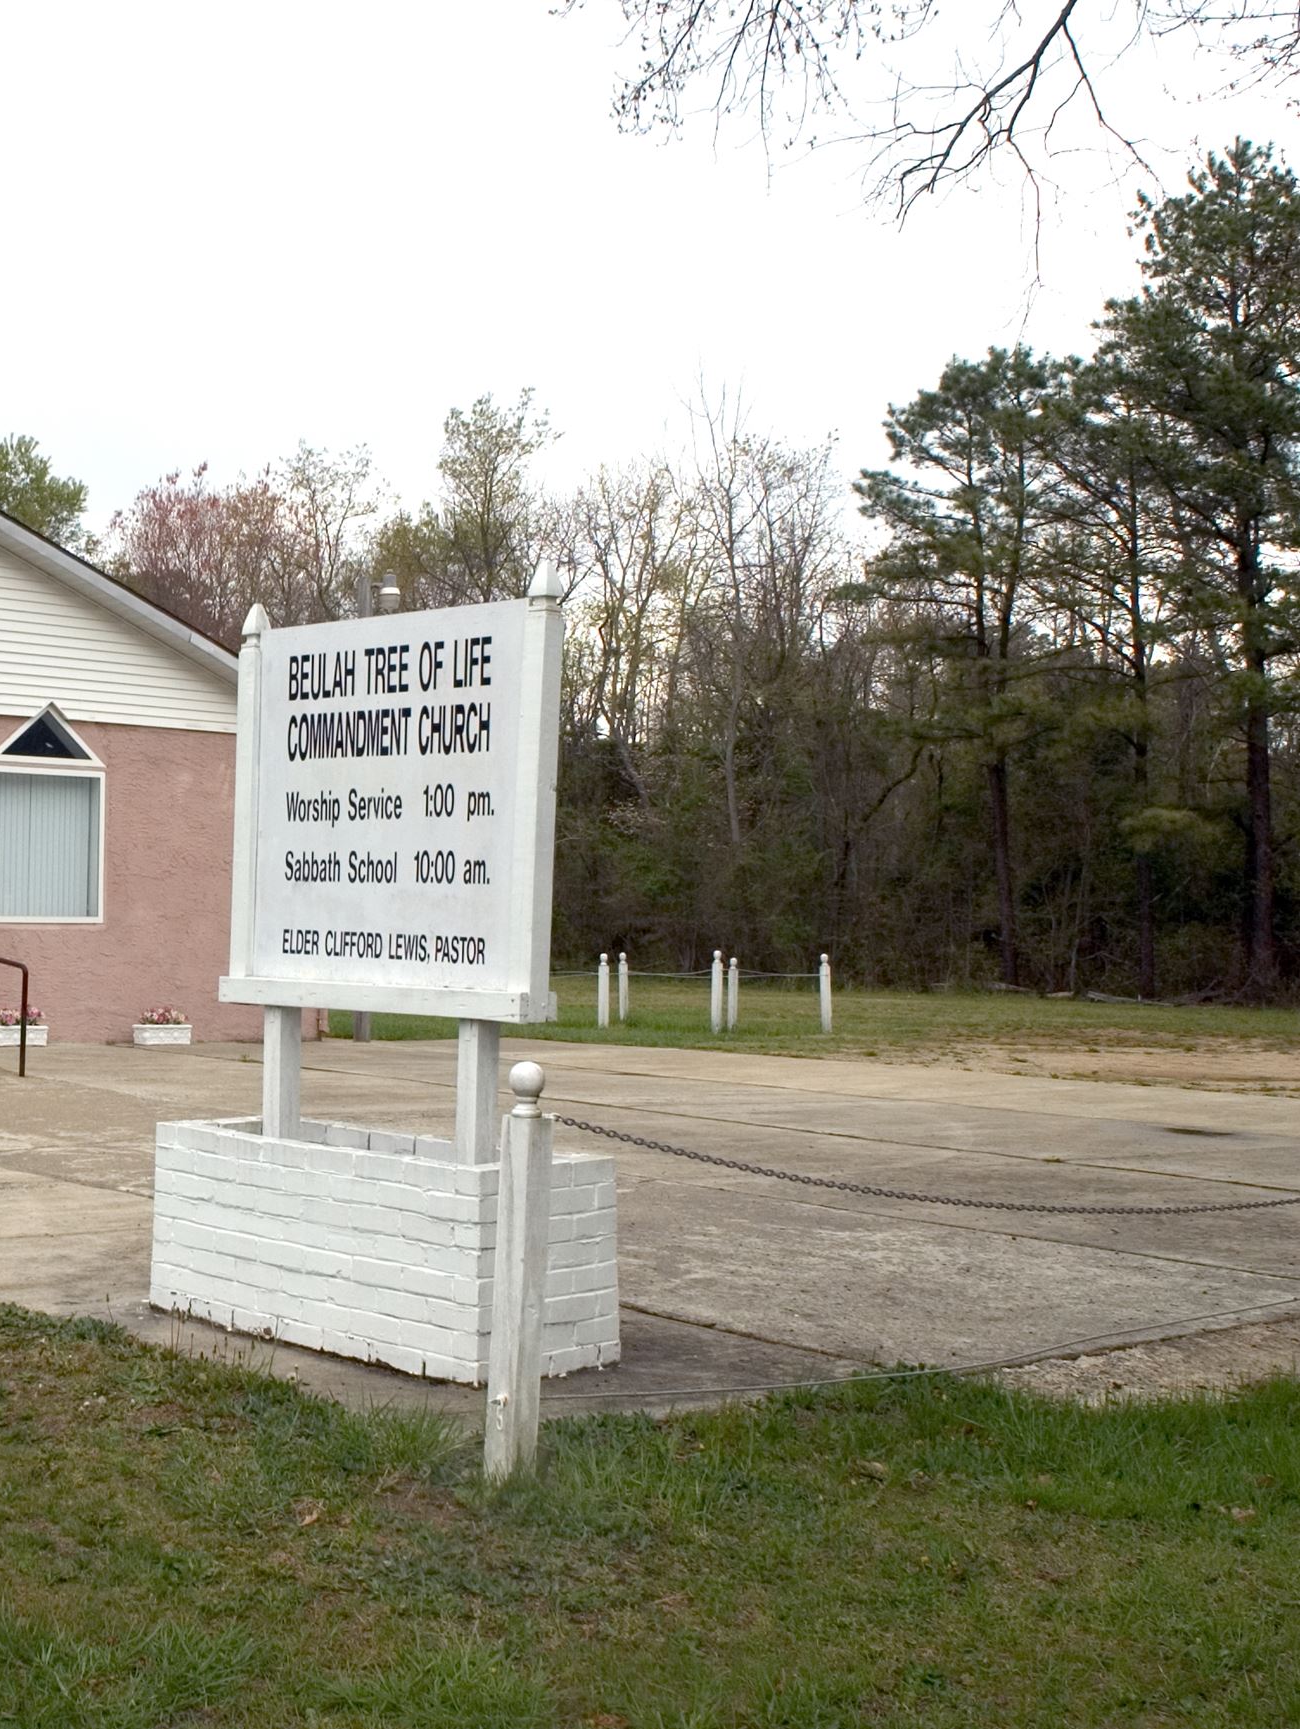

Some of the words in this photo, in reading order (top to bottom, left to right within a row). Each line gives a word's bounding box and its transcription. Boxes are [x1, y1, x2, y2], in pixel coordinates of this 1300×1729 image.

[289, 650, 355, 701] BEULAH
[365, 645, 409, 695] TREE
[419, 641, 444, 692] OF
[454, 636, 492, 688] LIFE
[288, 708, 411, 761] COMMANDMENT
[419, 702, 490, 755] CHURCH
[287, 791, 340, 827] Worship
[348, 788, 402, 821] Service
[423, 784, 454, 817] 1:00
[467, 792, 494, 821] pm.
[285, 851, 340, 882] Sabbath
[348, 851, 397, 883] School
[414, 850, 455, 884] 10:00
[464, 860, 489, 884] am.
[283, 929, 319, 954] ELDER
[325, 931, 382, 958] CLIFFORD
[389, 934, 429, 962] LEWIS,
[435, 936, 485, 964] PASTOR
